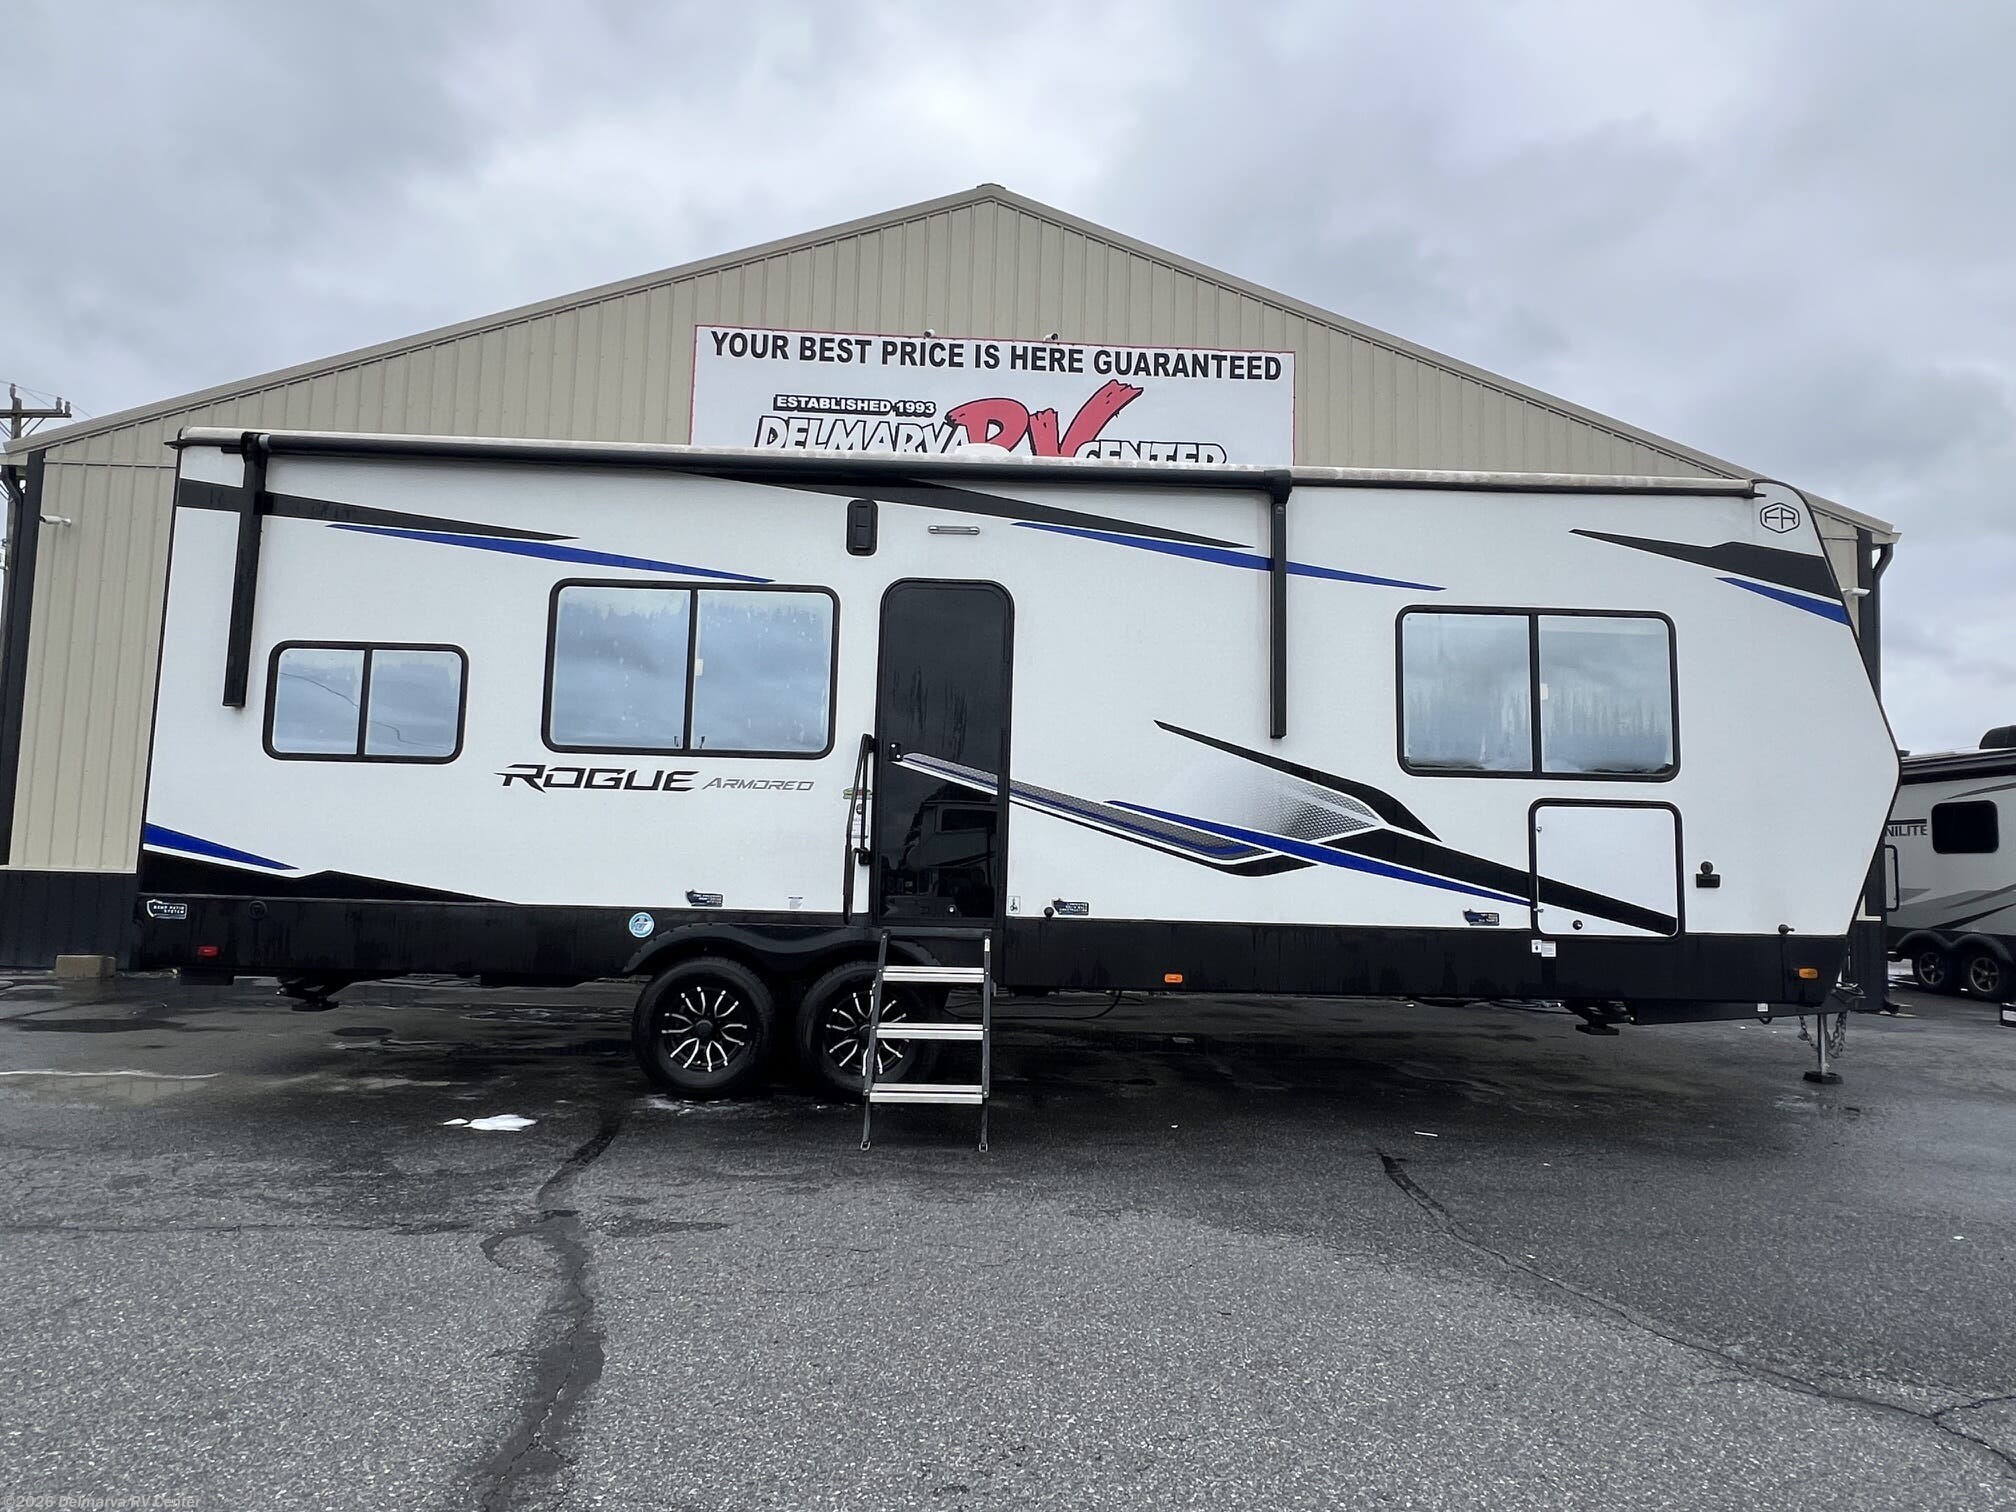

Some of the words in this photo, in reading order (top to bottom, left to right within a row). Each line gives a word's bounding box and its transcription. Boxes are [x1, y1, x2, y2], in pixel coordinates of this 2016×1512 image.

[711, 331, 789, 360] YOUR
[800, 337, 871, 364] BEST
[881, 341, 964, 368] PRICE
[975, 344, 1000, 370] IS
[1010, 346, 1084, 373] HERE
[1094, 350, 1281, 380] GUARANTEED
[754, 416, 970, 453] DELMARVA
[945, 379, 1143, 458] RV
[775, 396, 892, 413] ESTABLISHED
[897, 401, 936, 415] 1993
[494, 764, 700, 793] ROGUE
[702, 778, 814, 791] ARMORED
[1885, 824, 1928, 837] NILITE
